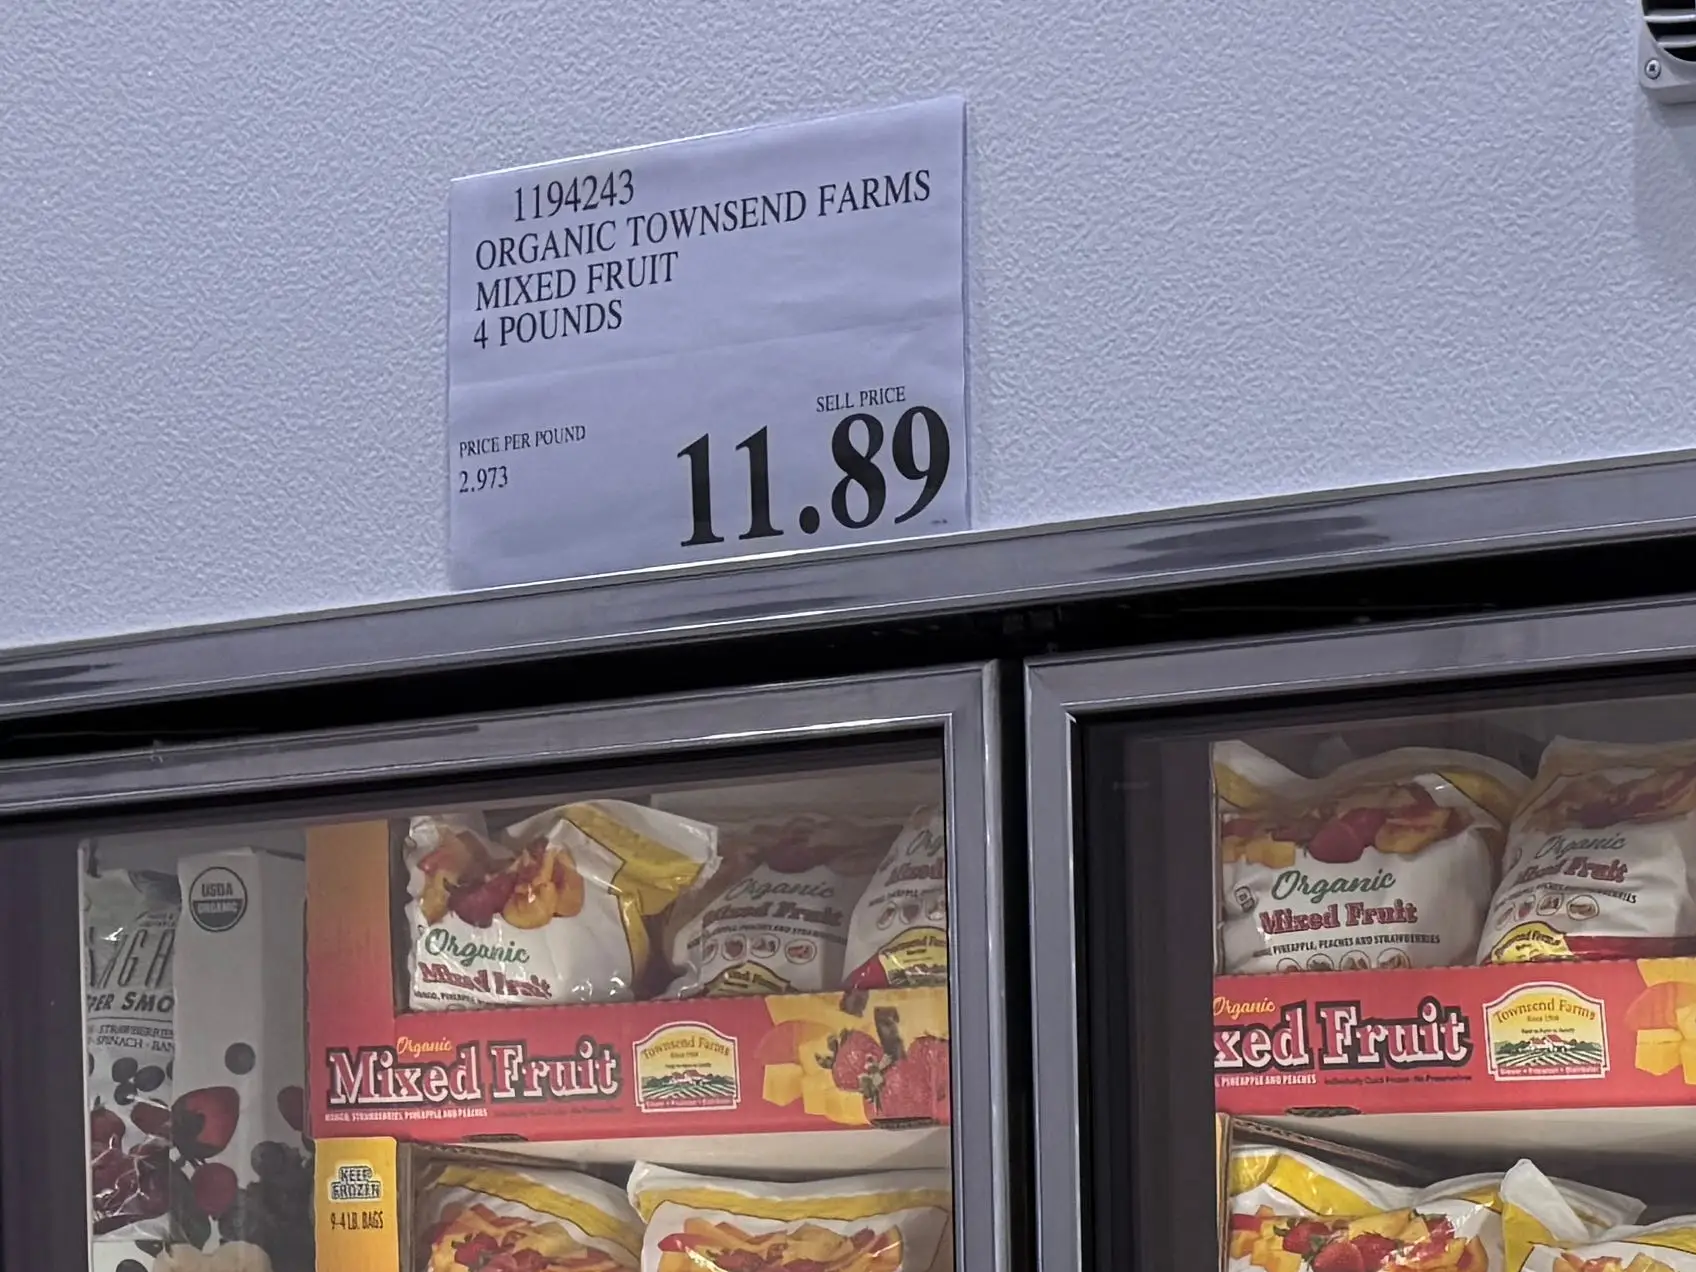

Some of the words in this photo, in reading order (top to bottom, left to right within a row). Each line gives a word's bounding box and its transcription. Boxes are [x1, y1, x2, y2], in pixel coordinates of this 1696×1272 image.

[476, 221, 617, 269] ORGANIC
[627, 190, 806, 247] TOWNSEND
[818, 170, 931, 216] FARMS
[513, 169, 635, 221] 1194243
[476, 268, 575, 311] MIXED
[587, 252, 679, 294] FRUIT
[474, 317, 489, 349] 4
[500, 300, 623, 347] POUNDS
[817, 393, 854, 412] SELL
[859, 386, 905, 408] PRICE
[459, 438, 500, 458] PRICE
[504, 433, 530, 453] PER
[535, 425, 586, 448] POUND
[459, 468, 509, 493] 2.973
[677, 406, 950, 547] 11.89
[1317, 999, 1474, 1070] Fruit
[329, 1038, 480, 1104] Mixed
[491, 1039, 620, 1100] Fruit
[363, 1211, 384, 1229] BAGS
